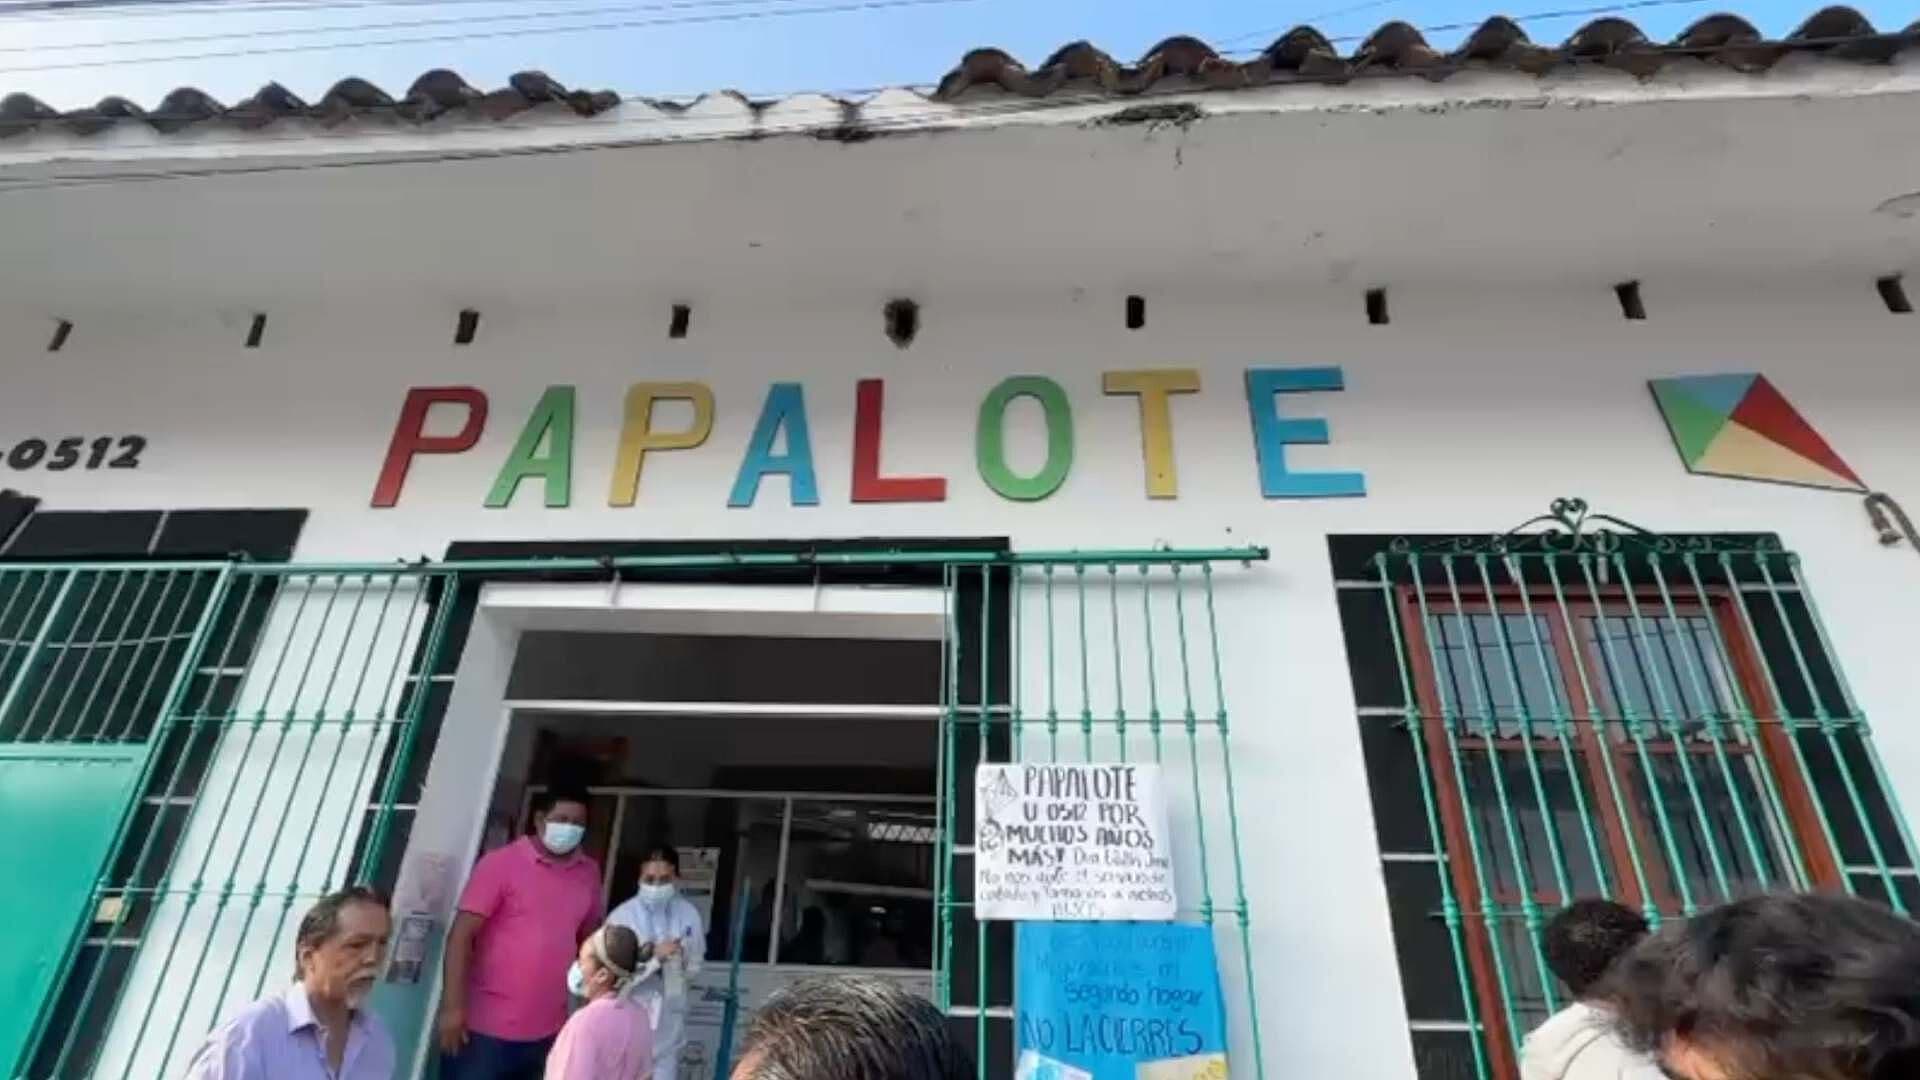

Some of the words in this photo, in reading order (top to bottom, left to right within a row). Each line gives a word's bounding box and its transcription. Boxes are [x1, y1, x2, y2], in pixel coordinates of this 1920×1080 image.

[0, 435, 147, 471] 0512
[369, 366, 1367, 508] PAPALOTE
[1023, 766, 1137, 801] PAPALOTE
[1023, 801, 1037, 822] U
[1098, 802, 1146, 828] POR
[1006, 824, 1088, 845] MUCHOS
[1020, 1011, 1054, 1050] NO
